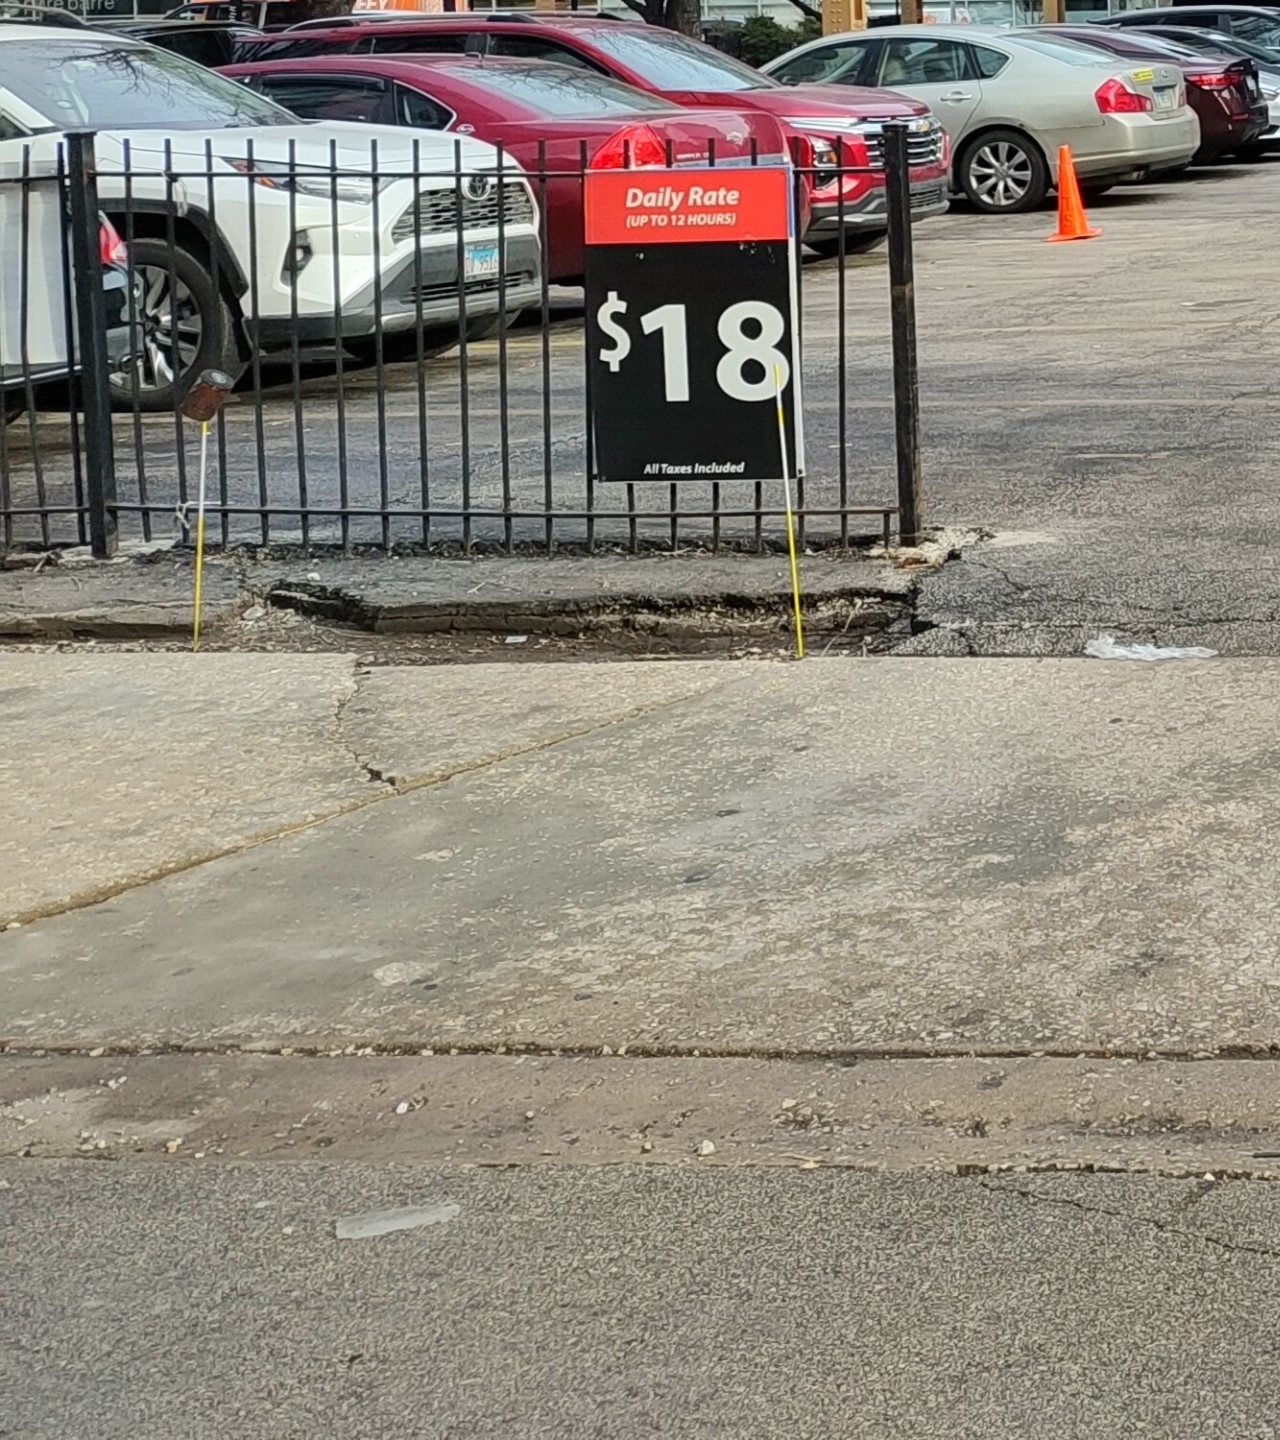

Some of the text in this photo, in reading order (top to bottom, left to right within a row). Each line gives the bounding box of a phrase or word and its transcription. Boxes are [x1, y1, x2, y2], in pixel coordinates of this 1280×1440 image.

[626, 186, 740, 212] Daily Rate
[626, 213, 736, 228] (UP TO 12 HOURS)
[597, 291, 790, 402] $18
[643, 461, 745, 474] All Taxes Included
